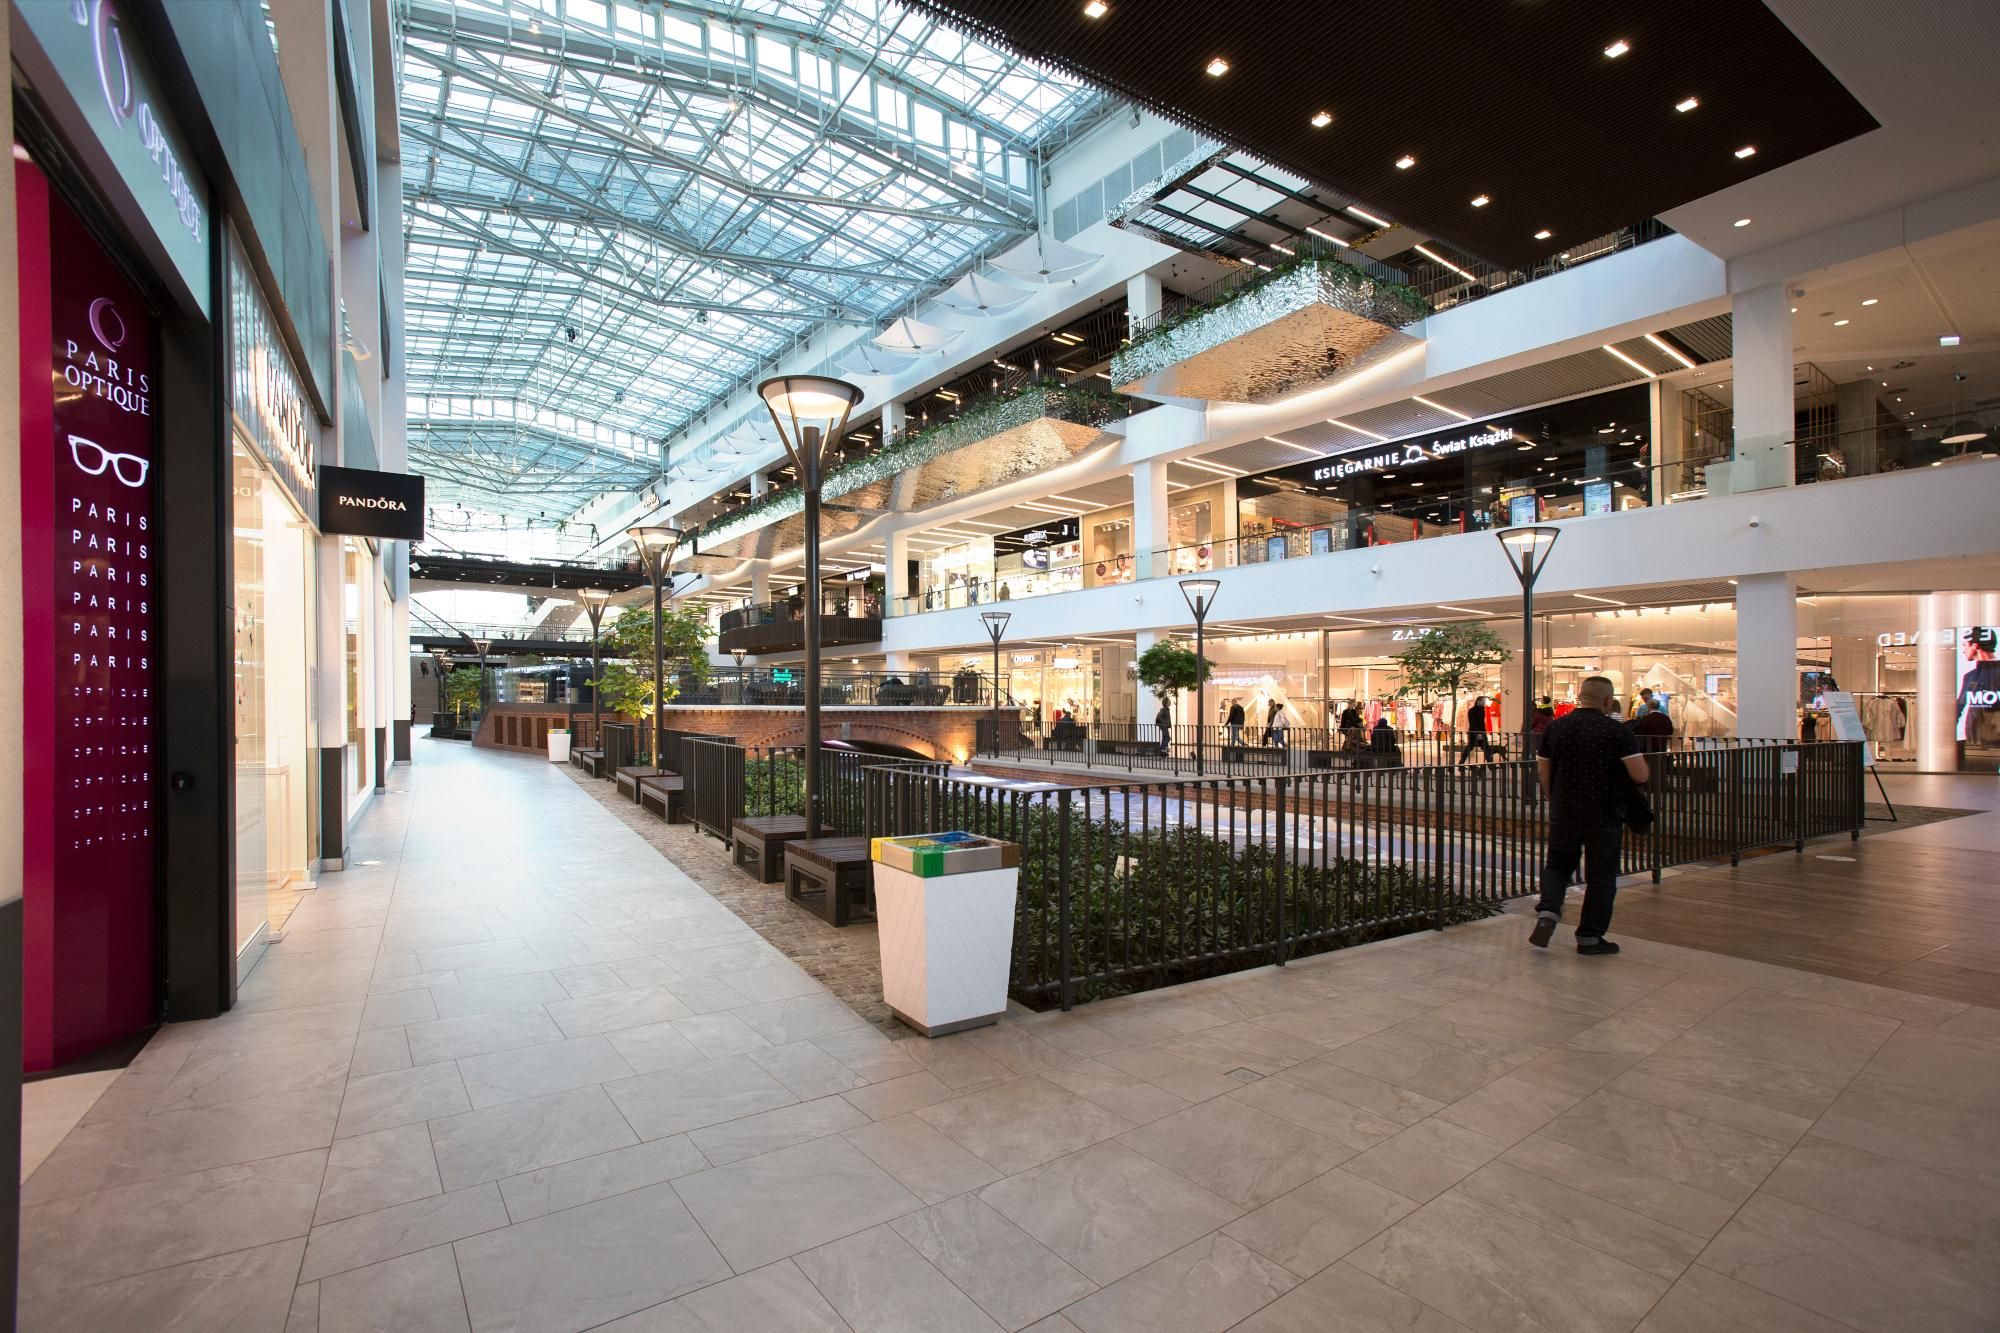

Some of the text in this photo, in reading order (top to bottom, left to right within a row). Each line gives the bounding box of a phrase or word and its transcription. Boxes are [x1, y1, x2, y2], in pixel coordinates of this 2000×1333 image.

[138, 102, 202, 243] OPTIQUE
[66, 338, 149, 393] PARIS
[64, 364, 150, 416] OPTIQUE
[1314, 427, 1513, 480] KSIĘGARNIE Świat Książki
[72, 498, 148, 531] PARIS
[72, 529, 148, 559] PARIS
[72, 561, 148, 587] PARIS
[72, 592, 148, 614] PARIS
[72, 622, 148, 642] PARIS
[72, 653, 148, 670] PARIS
[74, 687, 148, 697] OPTIQUE
[1966, 690, 2000, 705] MO
[74, 717, 148, 727] OPTIQUE
[74, 744, 148, 758] OPTIQUE
